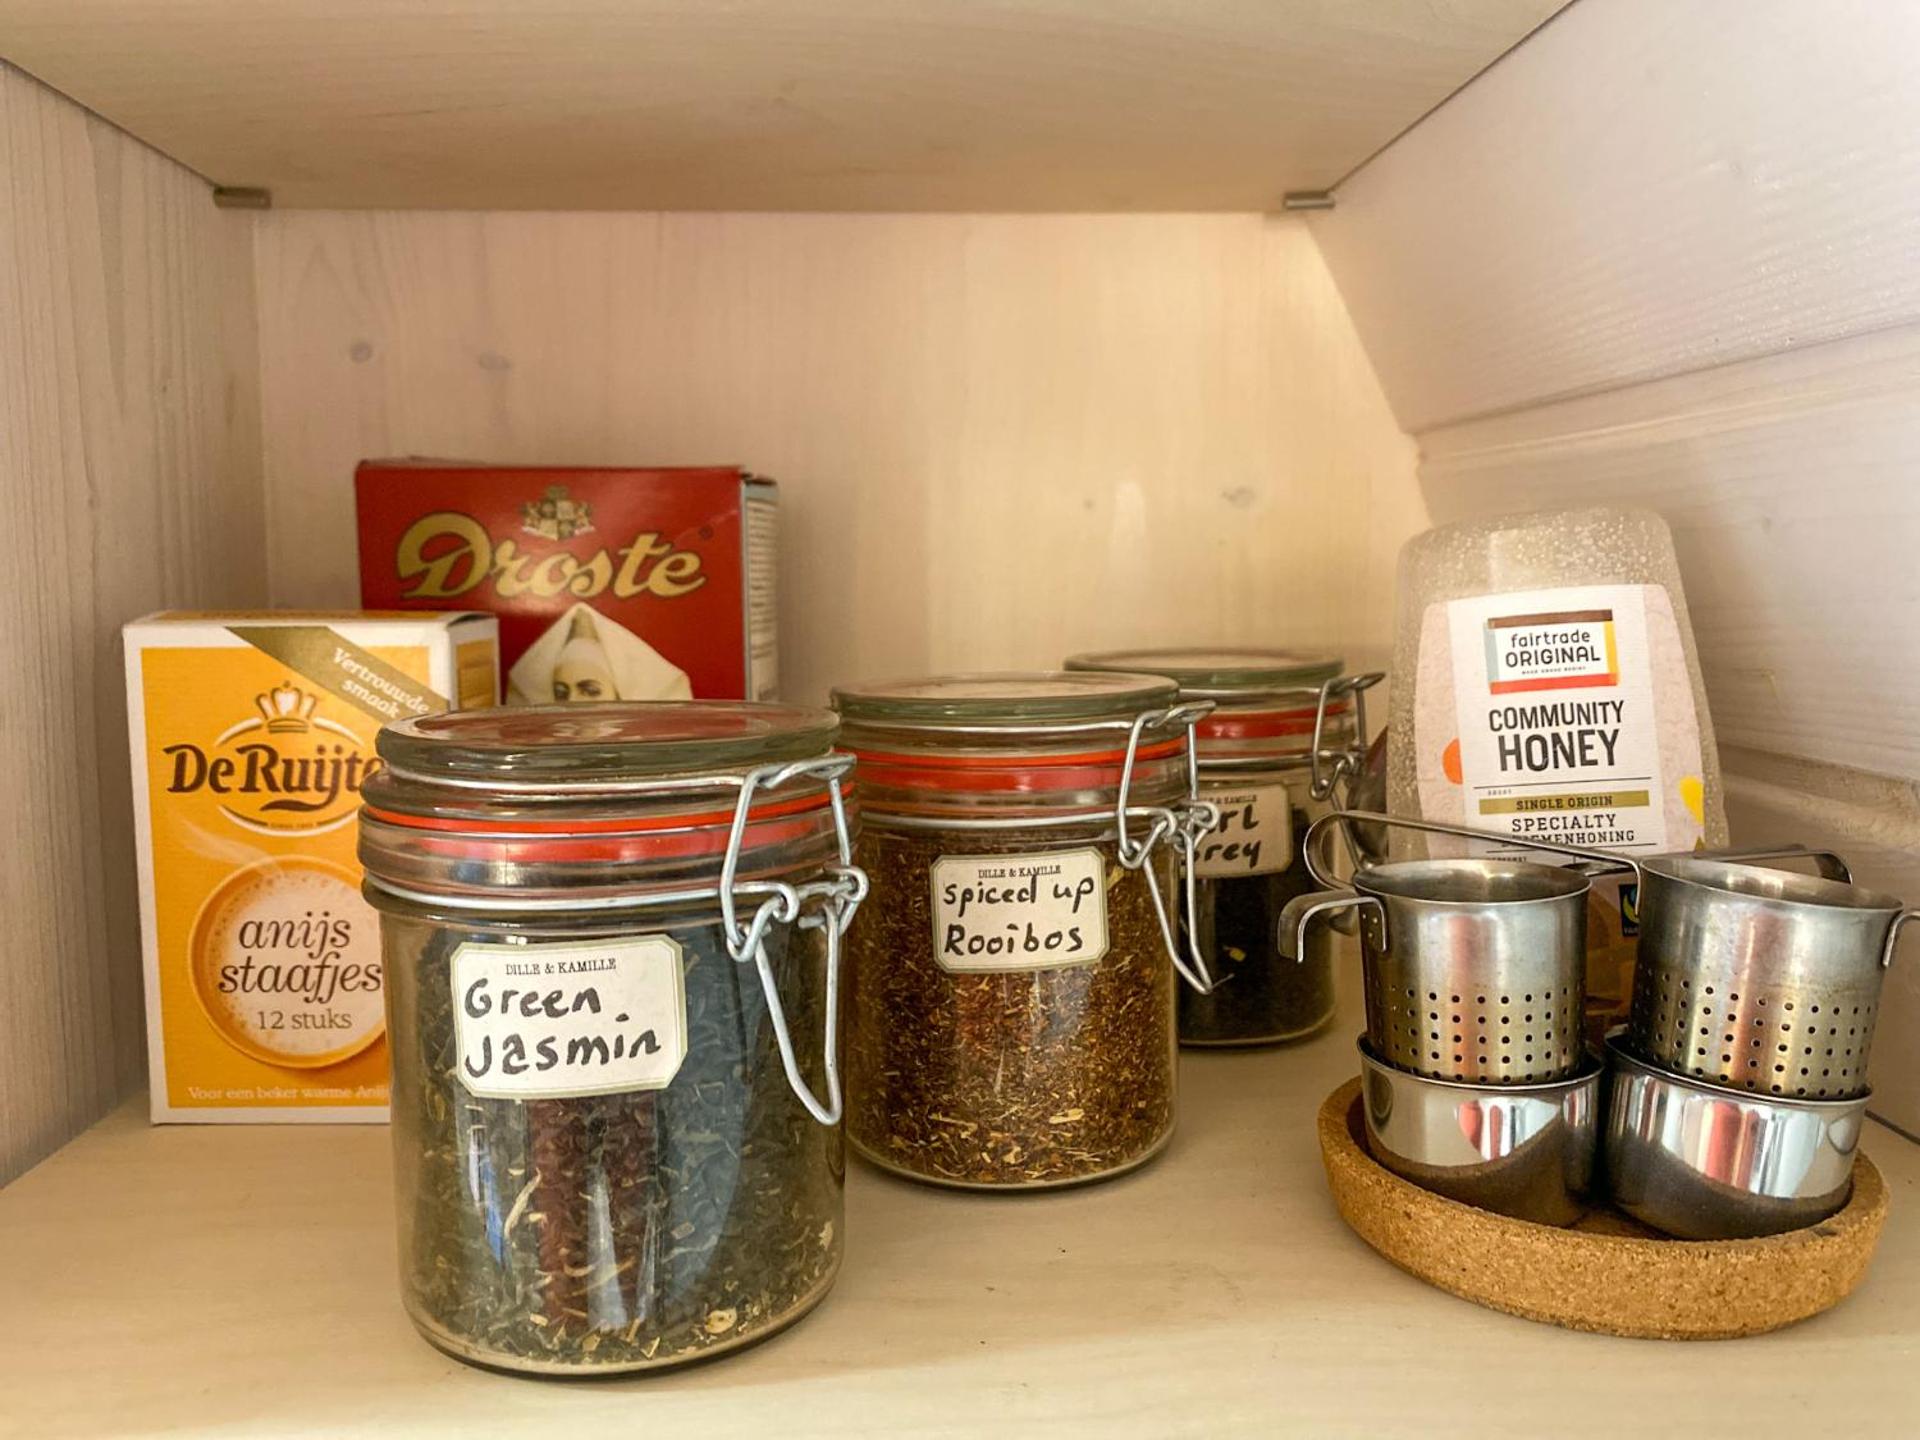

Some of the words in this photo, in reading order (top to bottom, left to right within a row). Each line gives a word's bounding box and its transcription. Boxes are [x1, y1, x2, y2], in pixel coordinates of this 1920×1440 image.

[396, 509, 707, 599] Droste
[1510, 628, 1591, 649] fairtrade
[1505, 645, 1600, 668] ORIGINAL
[334, 647, 430, 714] Vertrouwde
[341, 680, 399, 718] smaak
[1488, 700, 1624, 732] COMMUNITY
[1498, 729, 1620, 772] HONEY
[1207, 804, 1260, 833] rl
[1516, 798, 1564, 811] SINGLE
[1567, 795, 1613, 809] ORIGIN
[1512, 814, 1616, 832] SPECIALTY
[978, 868, 1006, 879] DILLE
[1008, 868, 1017, 878] &
[1019, 864, 1062, 877] KAMILLE
[943, 874, 1037, 917] spiced
[1053, 876, 1094, 913] up
[239, 911, 350, 960] anijs
[944, 922, 1083, 956] Rooibos
[218, 951, 382, 1004] staafjes
[505, 963, 541, 976] DILLE
[544, 962, 555, 974] &
[557, 957, 616, 974] KAMILLE
[465, 978, 601, 1018] Green
[258, 1010, 285, 1030] 12
[291, 1007, 353, 1030] stuks
[465, 1013, 661, 1078] Jasmin
